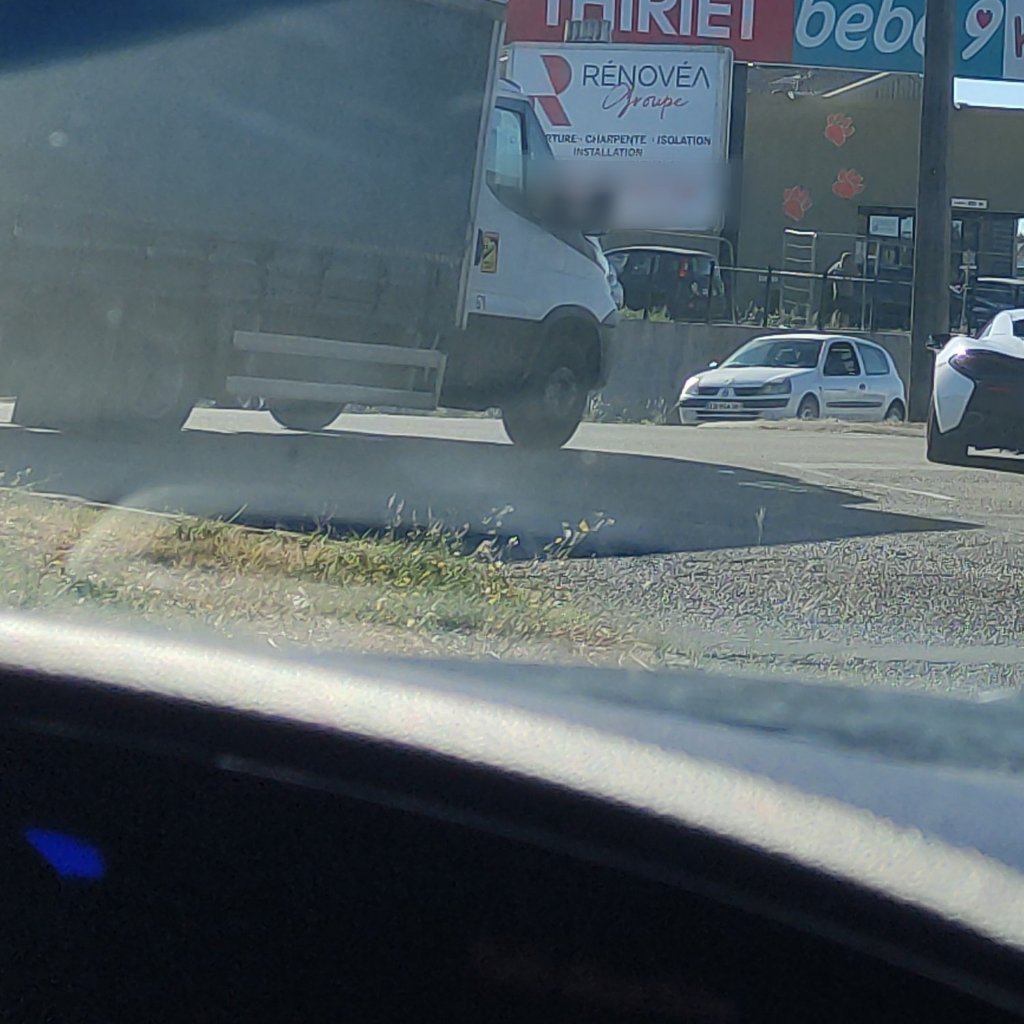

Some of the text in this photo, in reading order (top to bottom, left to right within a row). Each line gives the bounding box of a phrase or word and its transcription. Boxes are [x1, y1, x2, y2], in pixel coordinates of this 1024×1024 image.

[602, 81, 688, 119] Groupe
[585, 133, 647, 146] CHARPENTE
[656, 134, 712, 146] ISOLATION
[573, 147, 643, 157] INSTALLATION
